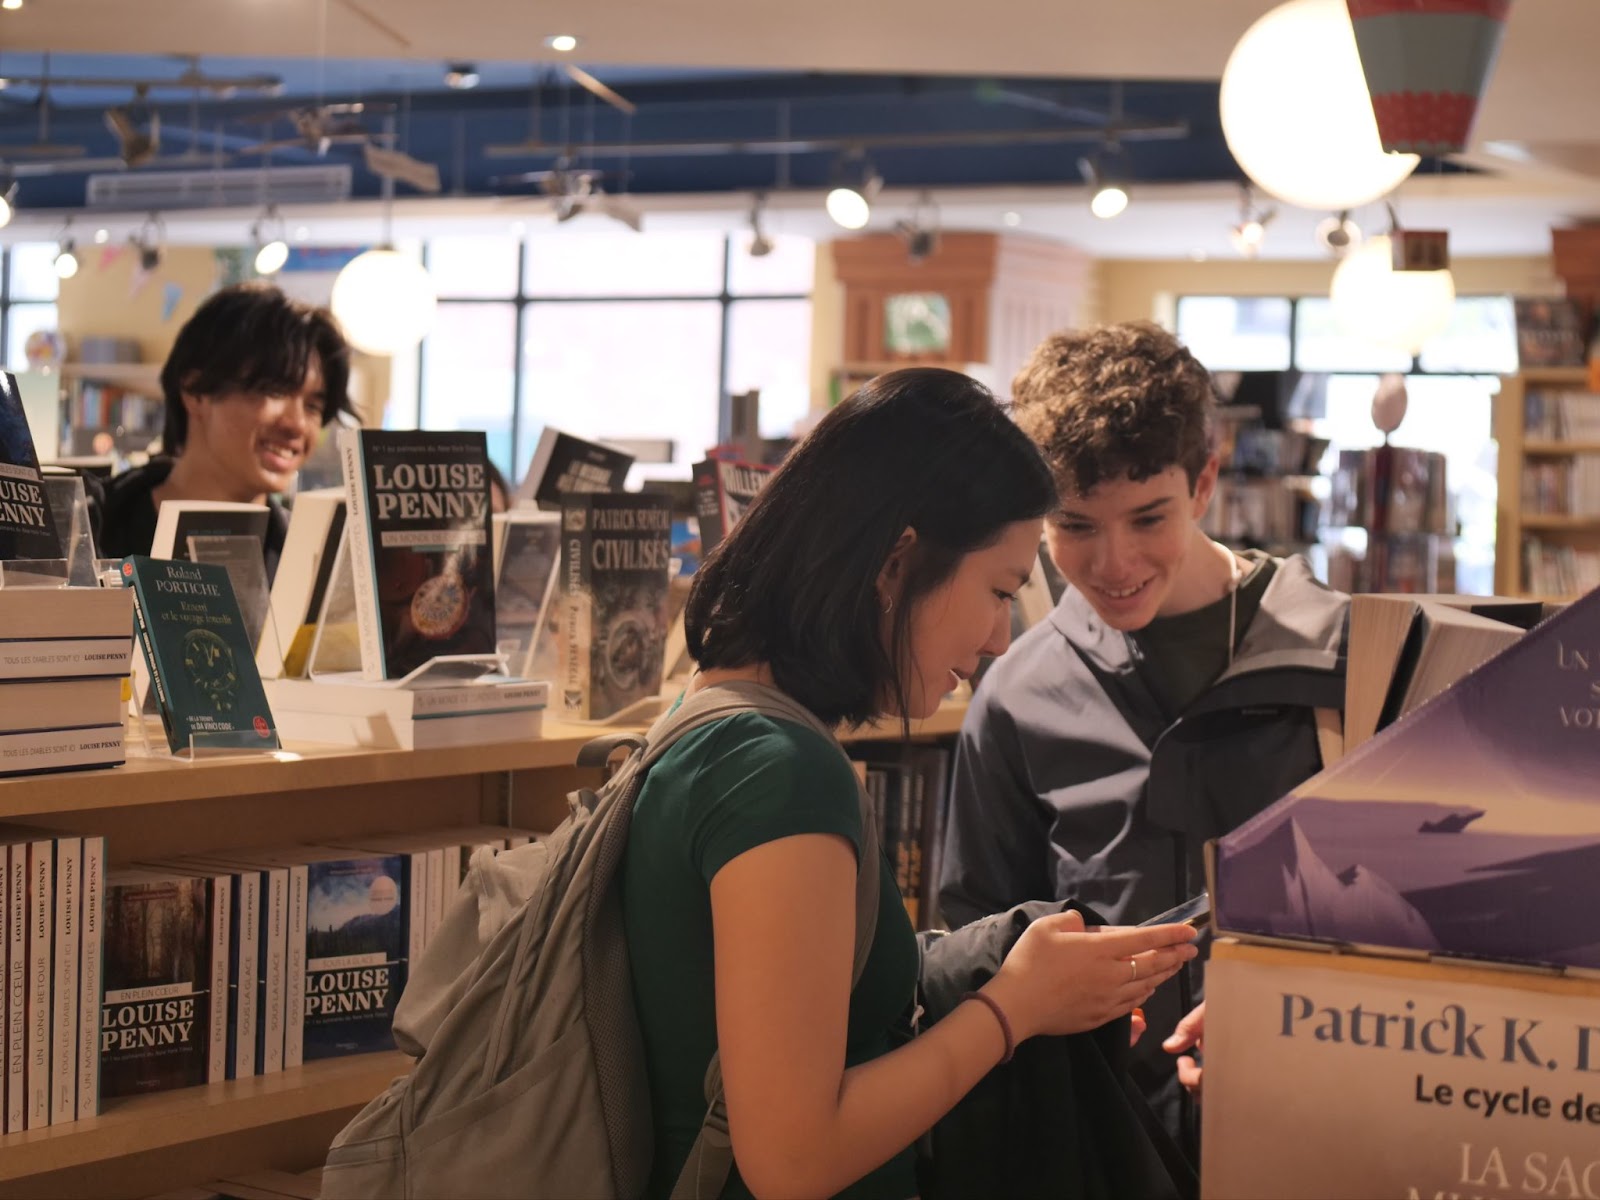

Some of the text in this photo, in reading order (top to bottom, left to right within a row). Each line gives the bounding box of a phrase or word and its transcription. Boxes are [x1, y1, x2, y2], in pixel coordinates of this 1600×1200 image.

[347, 448, 355, 481] PENNY
[373, 463, 484, 490] LOUISE
[0, 480, 42, 504] UISE
[350, 483, 358, 515] LOUISE
[376, 492, 486, 519] PENNY
[593, 509, 635, 530] PATRICK
[166, 566, 202, 580] Roland
[156, 580, 220, 596] PORTICHE
[4, 656, 19, 664] TOUS
[21, 656, 31, 664] LES
[56, 655, 71, 663] SONT
[196, 722, 204, 730] DA
[204, 722, 218, 730] VINCI
[218, 722, 232, 730] CODE
[1560, 705, 1600, 729] VO
[3, 749, 18, 757] TOUS
[19, 749, 29, 757] LES
[53, 745, 67, 754] SONT
[80, 742, 100, 750] LOUISE
[14, 961, 23, 1007] CŒUR
[38, 957, 46, 1003] RETOUR
[306, 968, 389, 994] LOUISE
[120, 987, 179, 1000] EN PLEIN CŒUR
[244, 991, 251, 1005] LA
[272, 987, 279, 1001] LA
[304, 988, 388, 1016] PENNY
[63, 988, 71, 1026] DIABLES
[86, 1009, 93, 1022] DE
[102, 999, 194, 1029] LOUISE
[271, 1003, 279, 1031] SOUS
[13, 1011, 22, 1050] PLEIN
[37, 1010, 45, 1042] LONG
[243, 1006, 251, 1035] SOUS
[1278, 992, 1488, 1060] Patrick
[1501, 1017, 1558, 1071] K.
[101, 1021, 193, 1052] PENNY
[216, 1028, 221, 1042] EN
[13, 1054, 22, 1074] EN
[36, 1048, 44, 1065] UN
[62, 1050, 70, 1075] TOUS
[84, 1073, 92, 1090] UN
[1415, 1074, 1454, 1105] Le
[1463, 1087, 1552, 1119] cycle
[1459, 1142, 1512, 1190] LA
